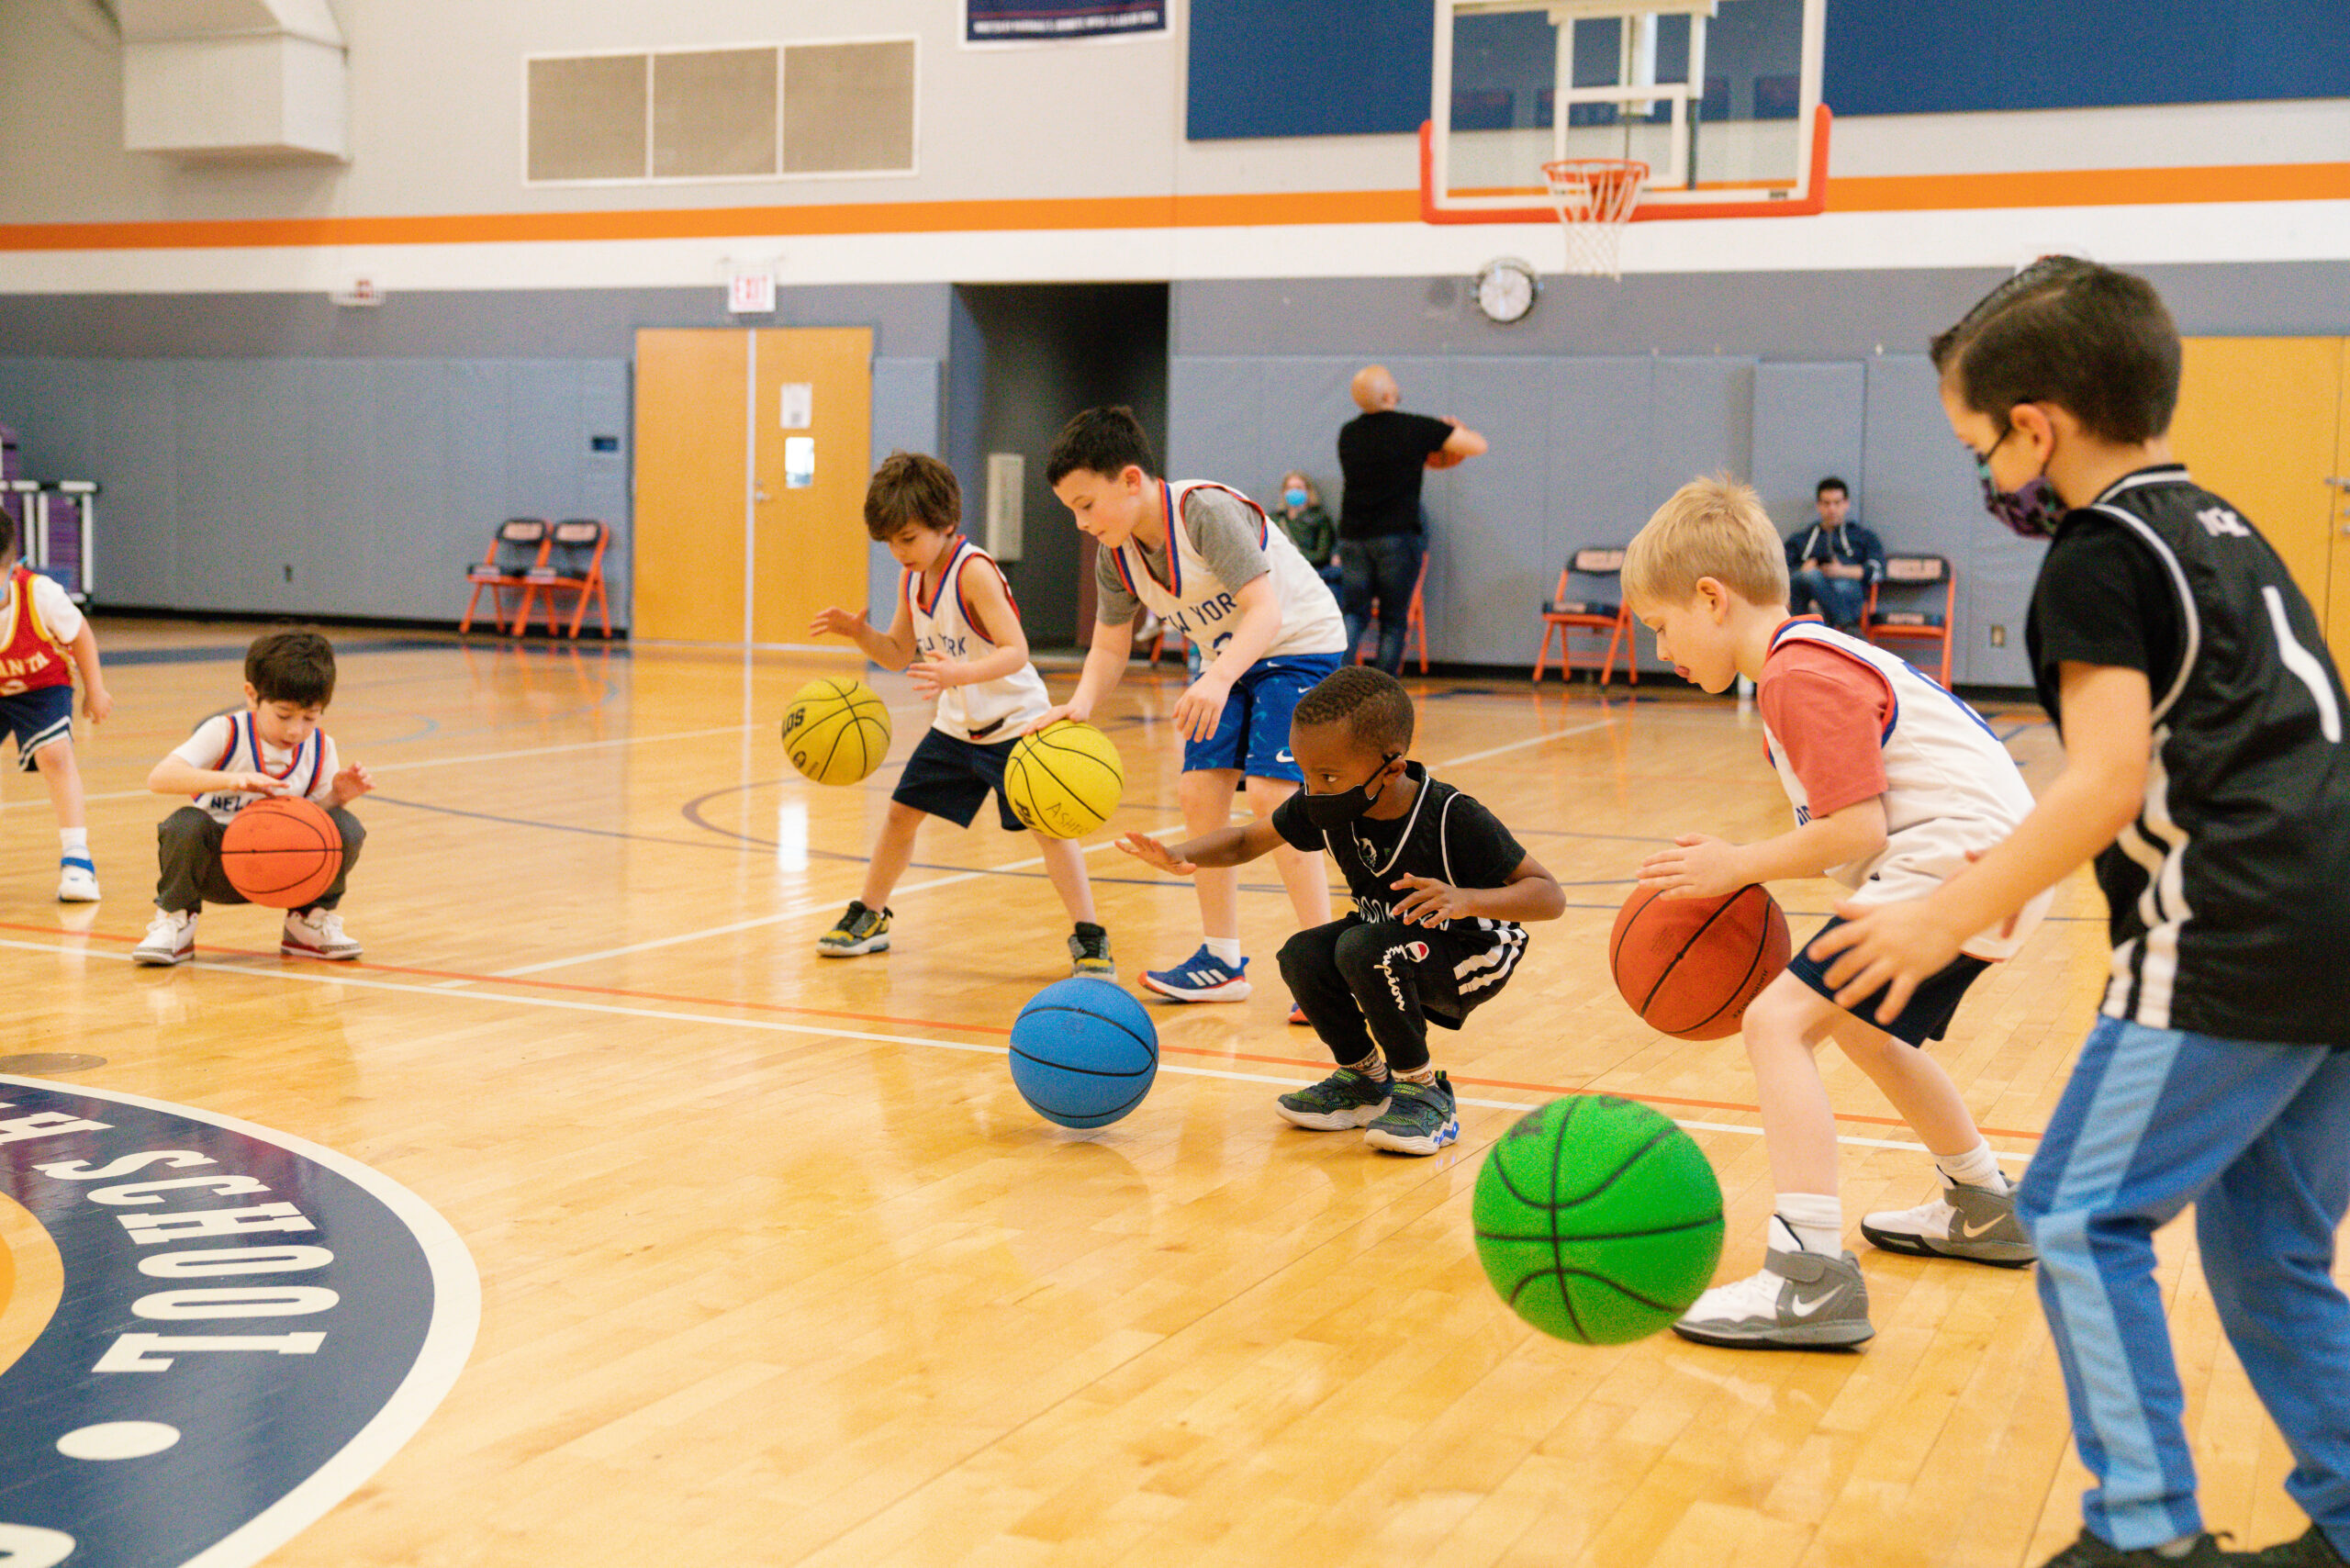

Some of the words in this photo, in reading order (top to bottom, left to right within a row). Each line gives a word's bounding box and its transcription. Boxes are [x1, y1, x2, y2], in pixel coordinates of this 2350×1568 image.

[733, 275, 768, 304] EXIT
[1189, 592, 1237, 625] YOR
[938, 633, 966, 656] YRK
[31, 1150, 340, 1372] SCHOOL
